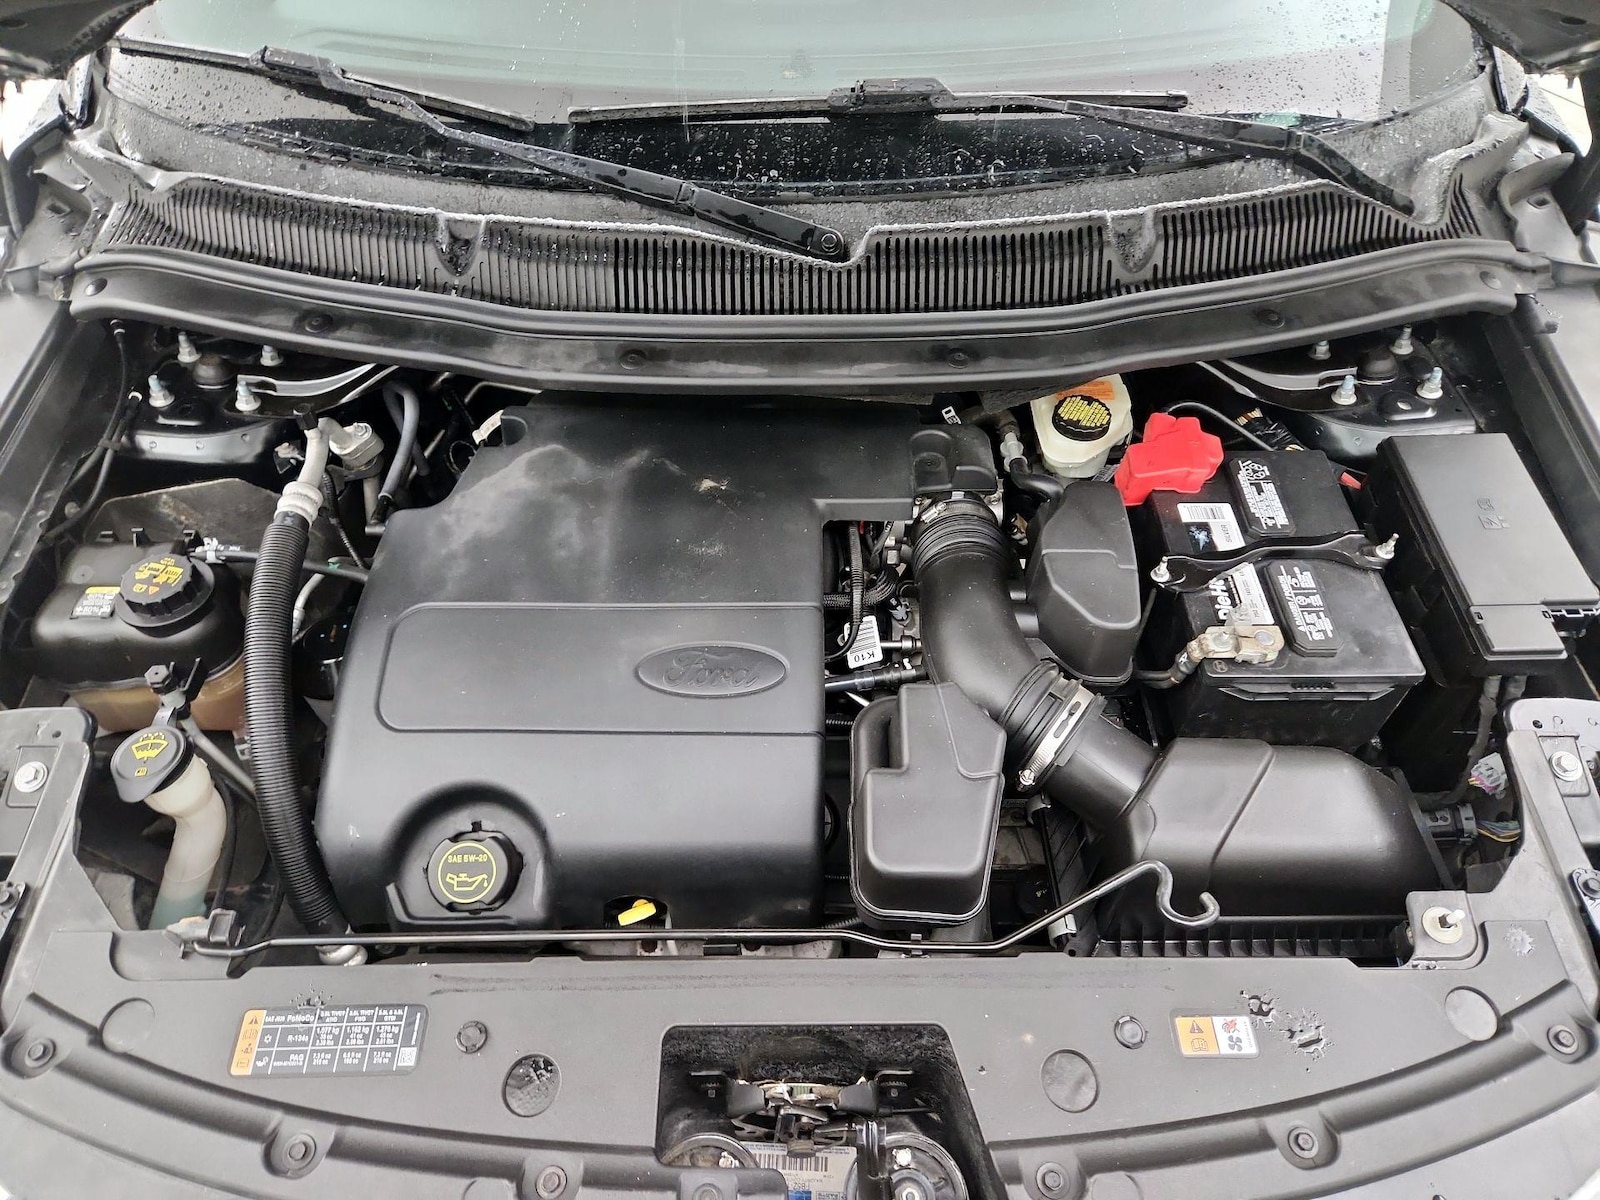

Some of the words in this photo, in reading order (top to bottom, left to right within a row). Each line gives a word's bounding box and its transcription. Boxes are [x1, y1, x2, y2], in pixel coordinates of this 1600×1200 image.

[1221, 524, 1233, 543] SILVER
[853, 650, 875, 663] K10
[662, 648, 759, 688] Ford
[447, 854, 462, 863] SAE
[463, 853, 488, 863] 5W-20
[286, 1014, 315, 1022] FoMoCo
[287, 1034, 309, 1042] R-134a
